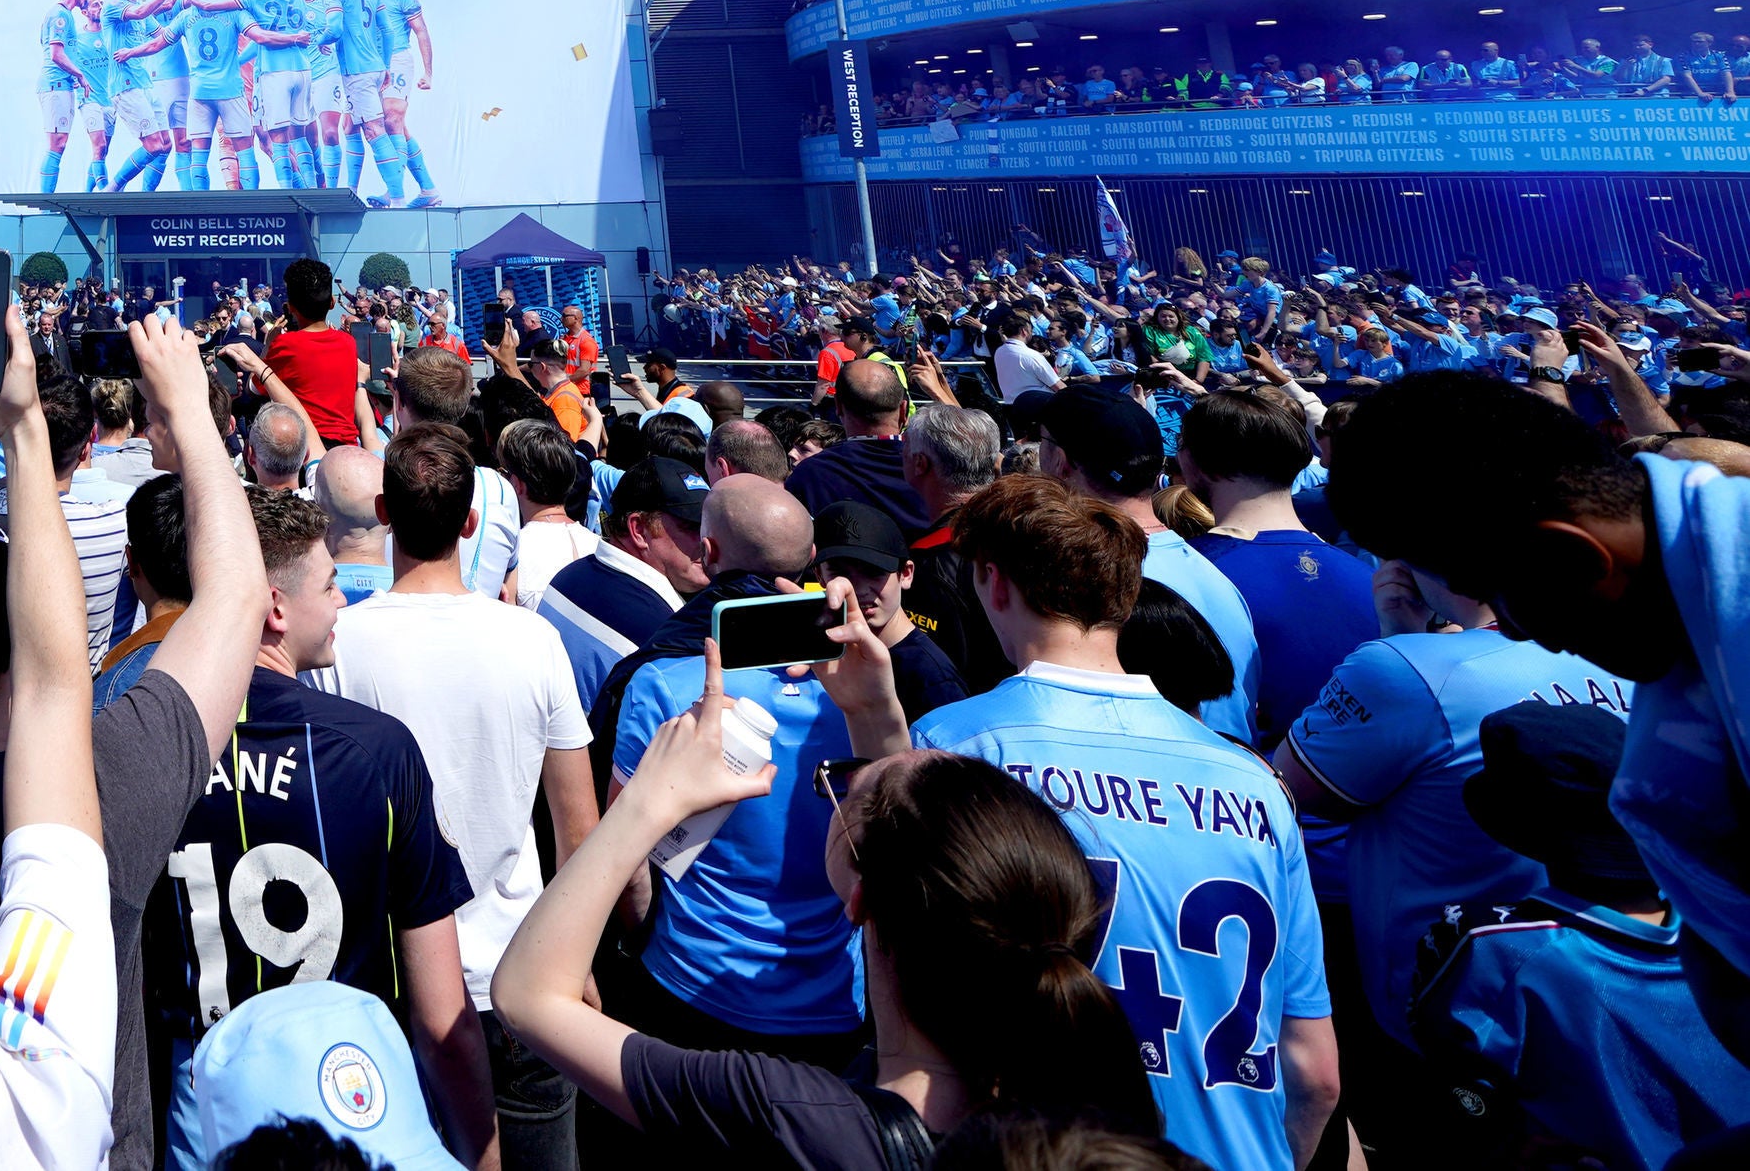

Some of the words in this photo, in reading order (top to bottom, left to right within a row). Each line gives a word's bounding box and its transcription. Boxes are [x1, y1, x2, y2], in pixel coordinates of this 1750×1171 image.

[198, 27, 219, 61] 8
[843, 49, 856, 81] WEST
[847, 84, 864, 148] RECEPTION
[1105, 120, 1183, 135] RAMSBOTTOM
[1200, 117, 1268, 132] REDBRIDGE
[1271, 114, 1333, 130] CITYZENS
[1353, 113, 1414, 127] REDDISH
[1434, 110, 1504, 125] REDONDO
[1508, 110, 1559, 124] BEACH
[1562, 108, 1611, 123] BLUES
[1634, 108, 1676, 122] ROSE
[1679, 108, 1714, 122] CITY
[1294, 132, 1368, 146] MORAVIAN
[1371, 130, 1438, 144] CITYZENS
[1458, 129, 1508, 144] SOUTH
[1511, 128, 1567, 142] STAFFS
[1589, 127, 1641, 141] SOUTH
[1643, 127, 1737, 142] YORKSHIRE
[1314, 149, 1374, 163] TRIPURA
[1377, 148, 1444, 162] CITYZENS
[1470, 147, 1515, 161] TUNIS
[1540, 146, 1655, 161] ULAANBAATAR
[151, 218, 194, 230] COLIN
[198, 218, 234, 229] BELL
[238, 217, 286, 229] STAND
[153, 235, 195, 247] WEST
[199, 234, 285, 246] RECEPTION
[356, 578, 373, 588] CITY
[205, 746, 298, 801] ANÉ
[1006, 763, 1169, 827] TOURE
[1174, 783, 1276, 849] YAYA
[168, 842, 344, 1029] 19
[1086, 857, 1279, 1093] 42
[324, 1049, 372, 1083] MANCHESTER
[356, 1113, 376, 1126] CITY
